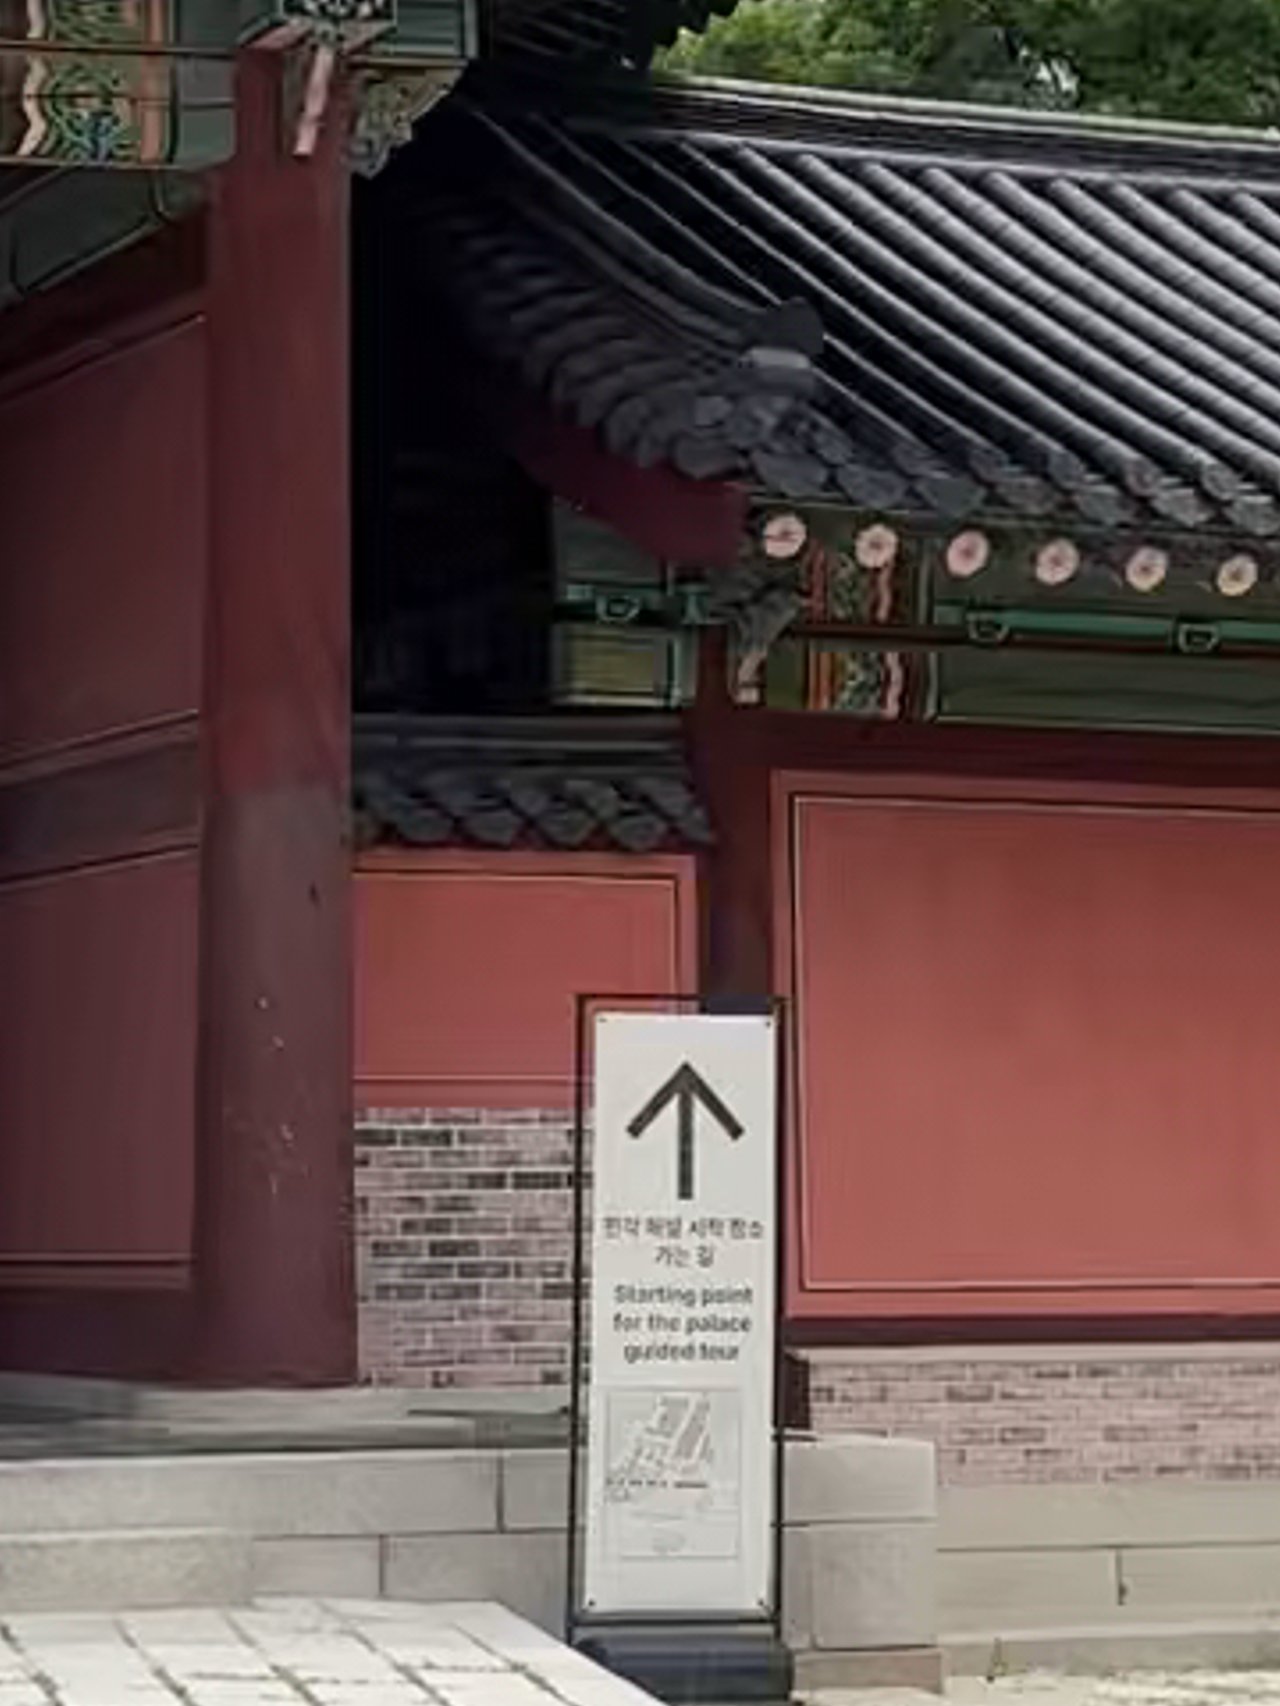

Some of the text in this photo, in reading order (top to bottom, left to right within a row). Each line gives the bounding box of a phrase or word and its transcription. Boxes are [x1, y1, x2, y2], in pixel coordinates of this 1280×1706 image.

[655, 1244, 715, 1268] 가는 길
[614, 1284, 753, 1308] Starting point
[613, 1313, 752, 1335] for the palace
[624, 1342, 739, 1364] guided tour
